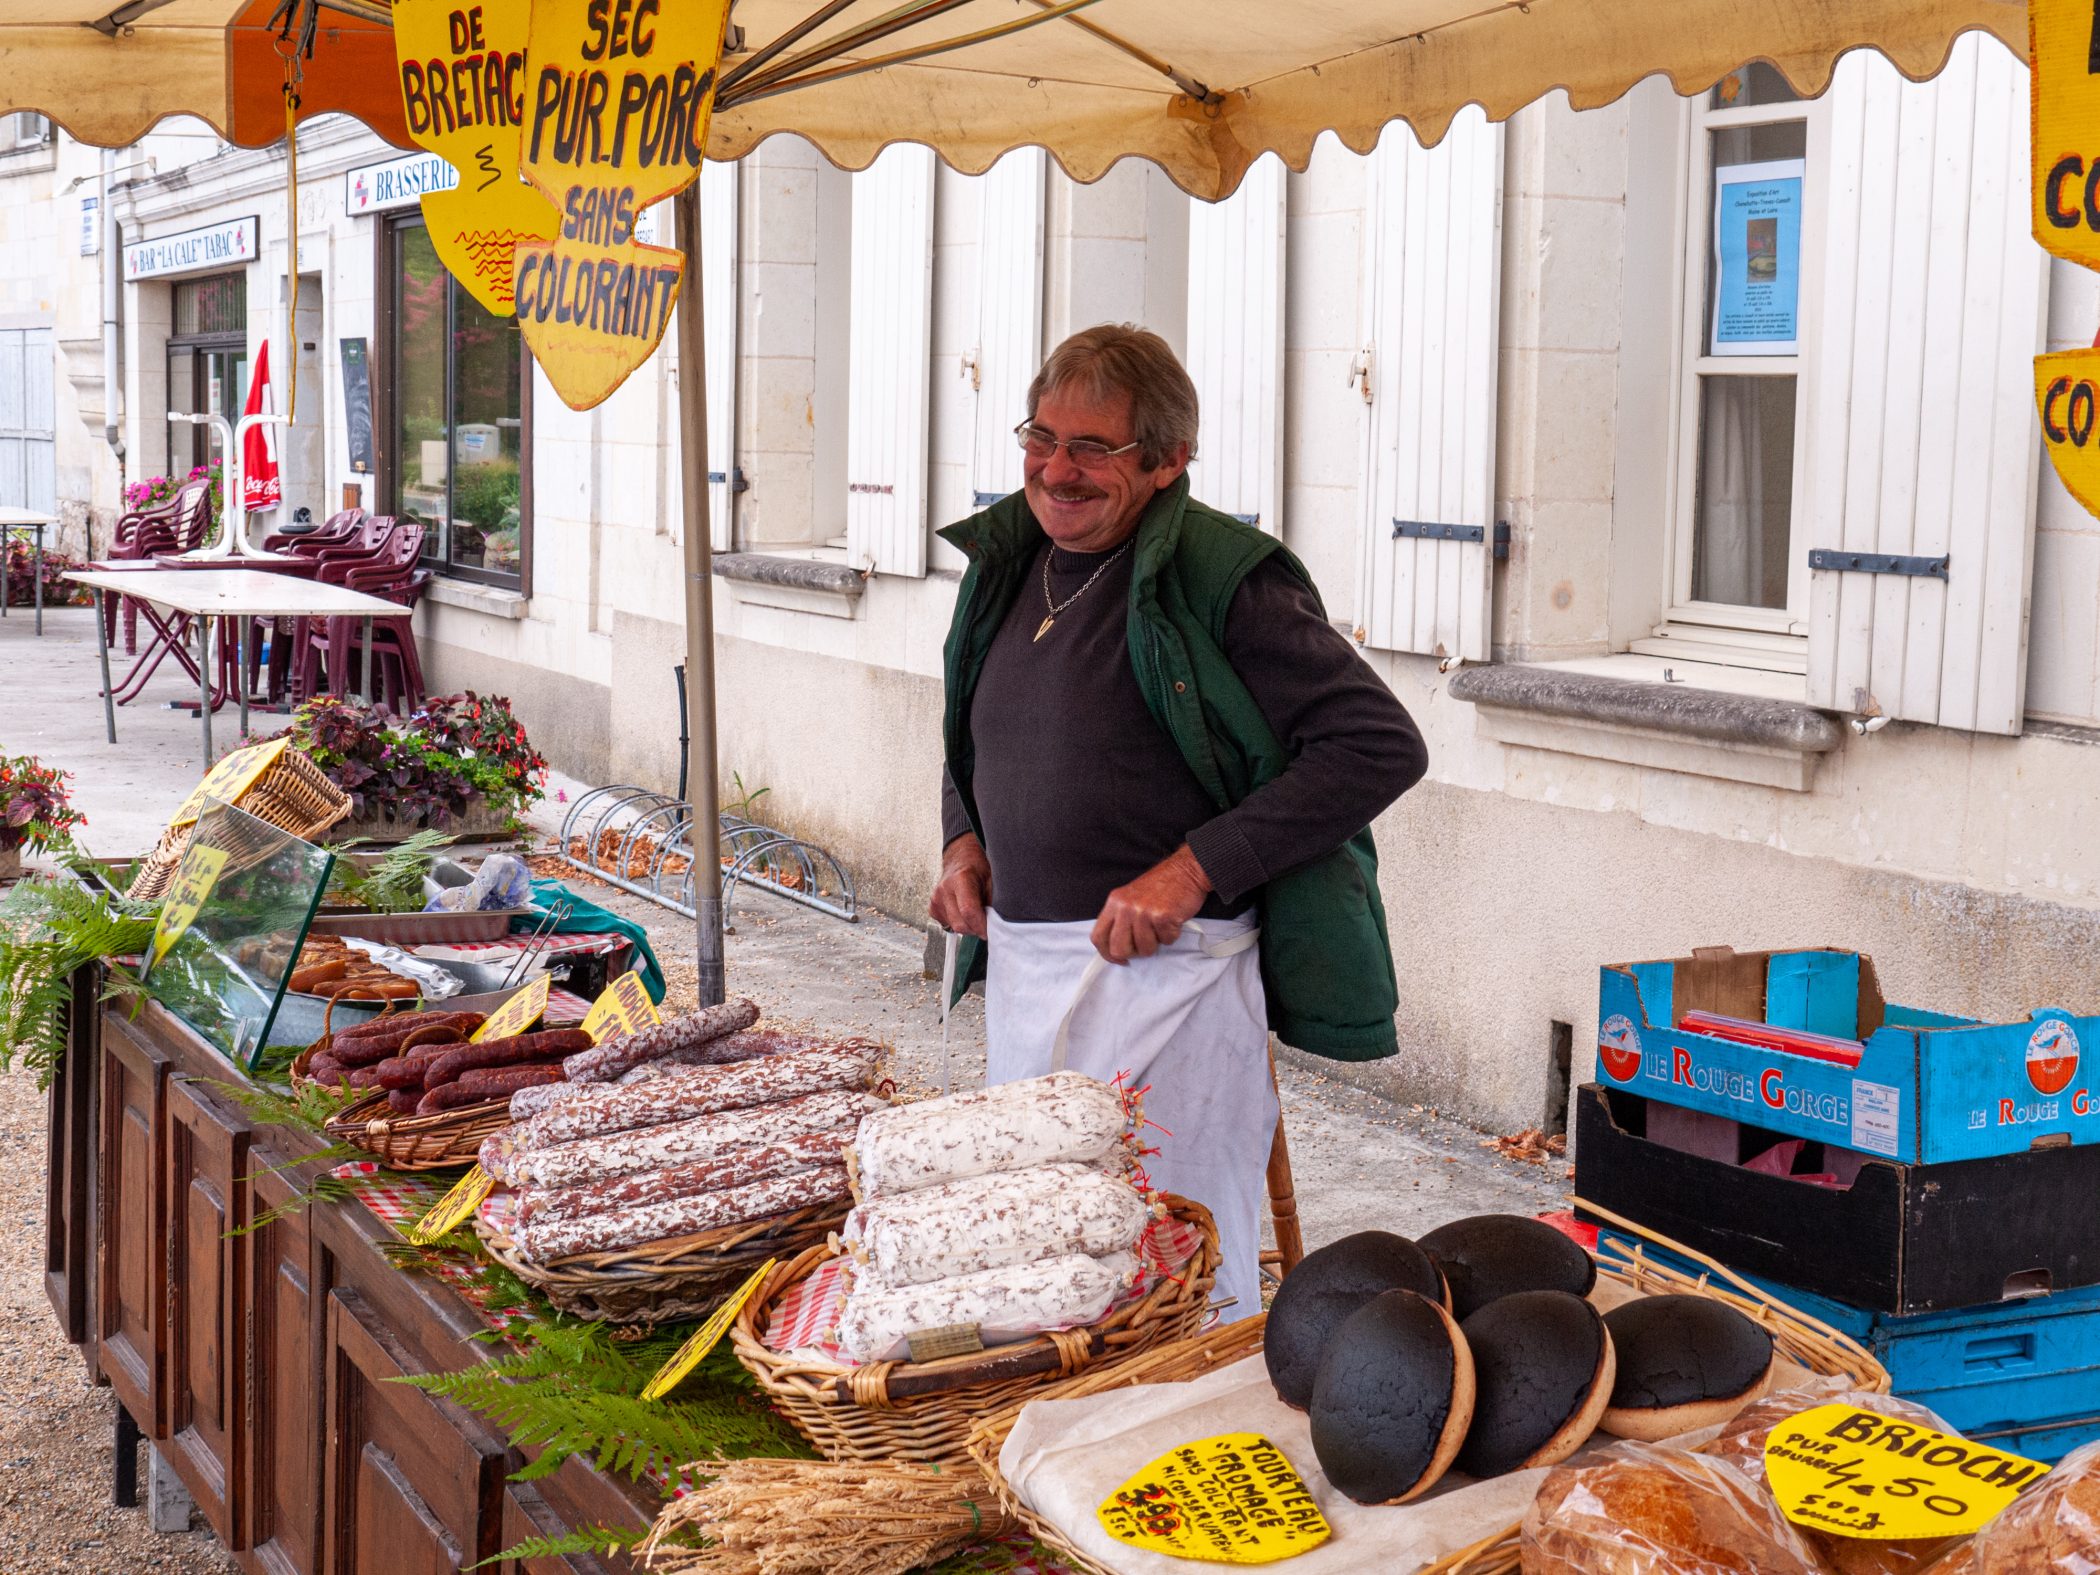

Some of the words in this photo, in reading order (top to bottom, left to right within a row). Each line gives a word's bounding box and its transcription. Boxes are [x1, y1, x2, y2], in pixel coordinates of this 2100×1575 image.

[449, 6, 486, 54] DE
[581, 0, 661, 61] SEC
[401, 48, 527, 137] BRETAG
[529, 65, 612, 168] PUR
[612, 60, 717, 168] PORC
[376, 160, 457, 201] BRASSERIE
[563, 184, 635, 247] SANS
[139, 250, 155, 272] BAR
[204, 230, 233, 260] TABAC
[515, 252, 679, 340] COLORANT
[1645, 1051, 1668, 1081] LE
[1671, 1046, 1755, 1102] ROUGE
[1759, 1067, 1849, 1126] GORGE
[1968, 1108, 1987, 1129] LE
[1997, 1097, 2059, 1126] ROUGE
[1785, 1433, 1839, 1455] PUR
[1175, 1448, 1207, 1476] SANS
[1197, 1480, 1260, 1546] COLORANT
[1242, 1438, 1329, 1535] TOURTEAU
